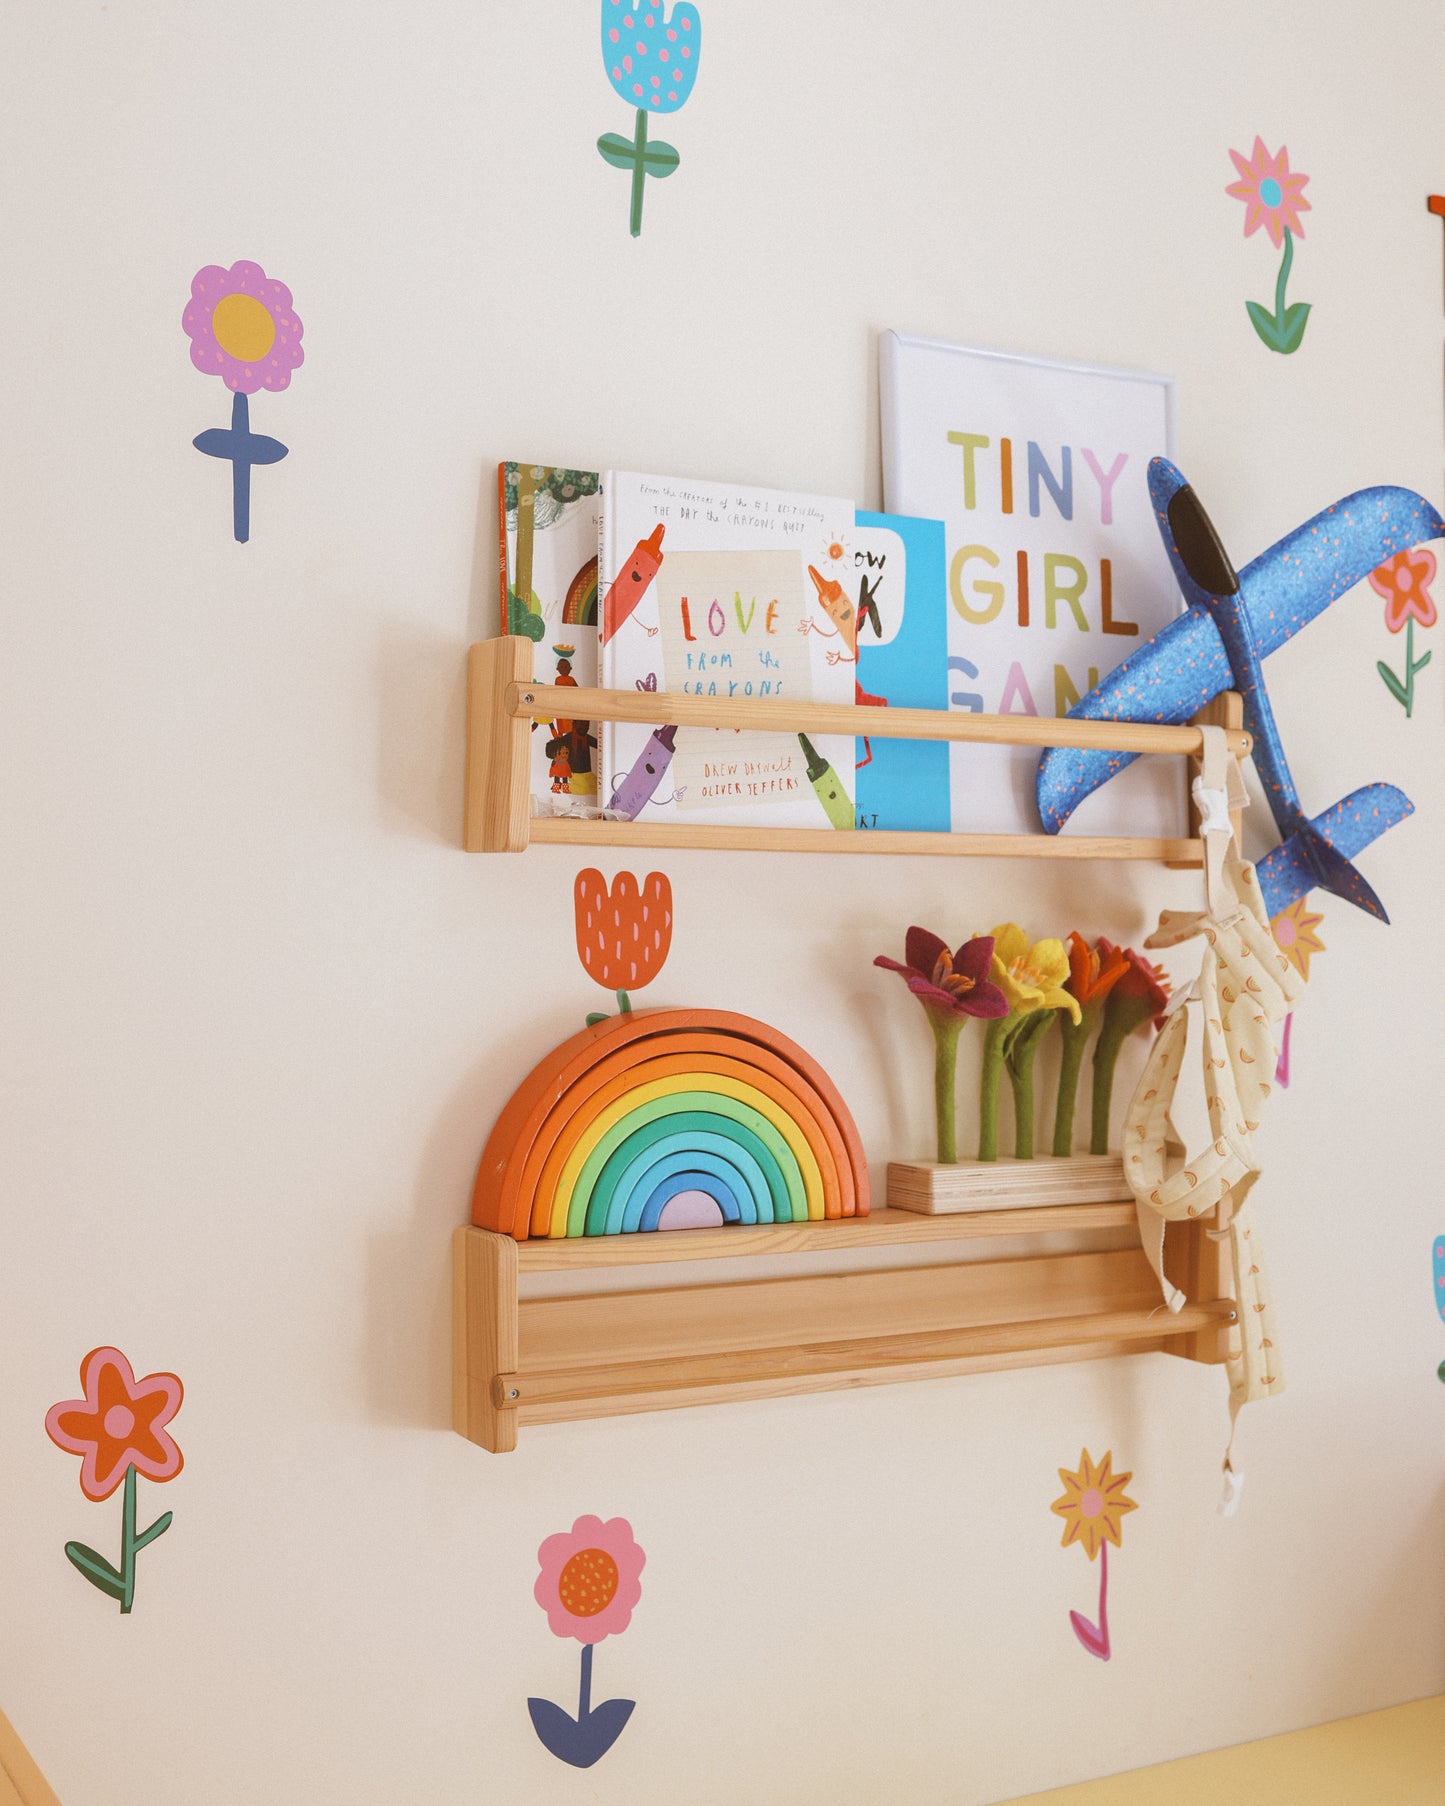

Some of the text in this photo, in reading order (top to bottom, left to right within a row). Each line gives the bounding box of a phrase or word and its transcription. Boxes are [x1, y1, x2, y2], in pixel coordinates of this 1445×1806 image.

[947, 430, 1129, 525] TINY
[639, 484, 660, 494] From
[663, 487, 677, 497] the
[719, 498, 728, 509] of
[653, 505, 671, 516] THE
[680, 506, 699, 519] DAY
[706, 509, 720, 522] the
[727, 513, 775, 529] CRAYONS
[950, 544, 1139, 636] GIRL
[680, 591, 779, 641] LOVE
[686, 650, 780, 671] FROM the
[684, 680, 782, 697] CRAYONS
[704, 763, 738, 778] DREW
[701, 777, 799, 797] OLIVER JEFFERS
[855, 814, 879, 828] RT
